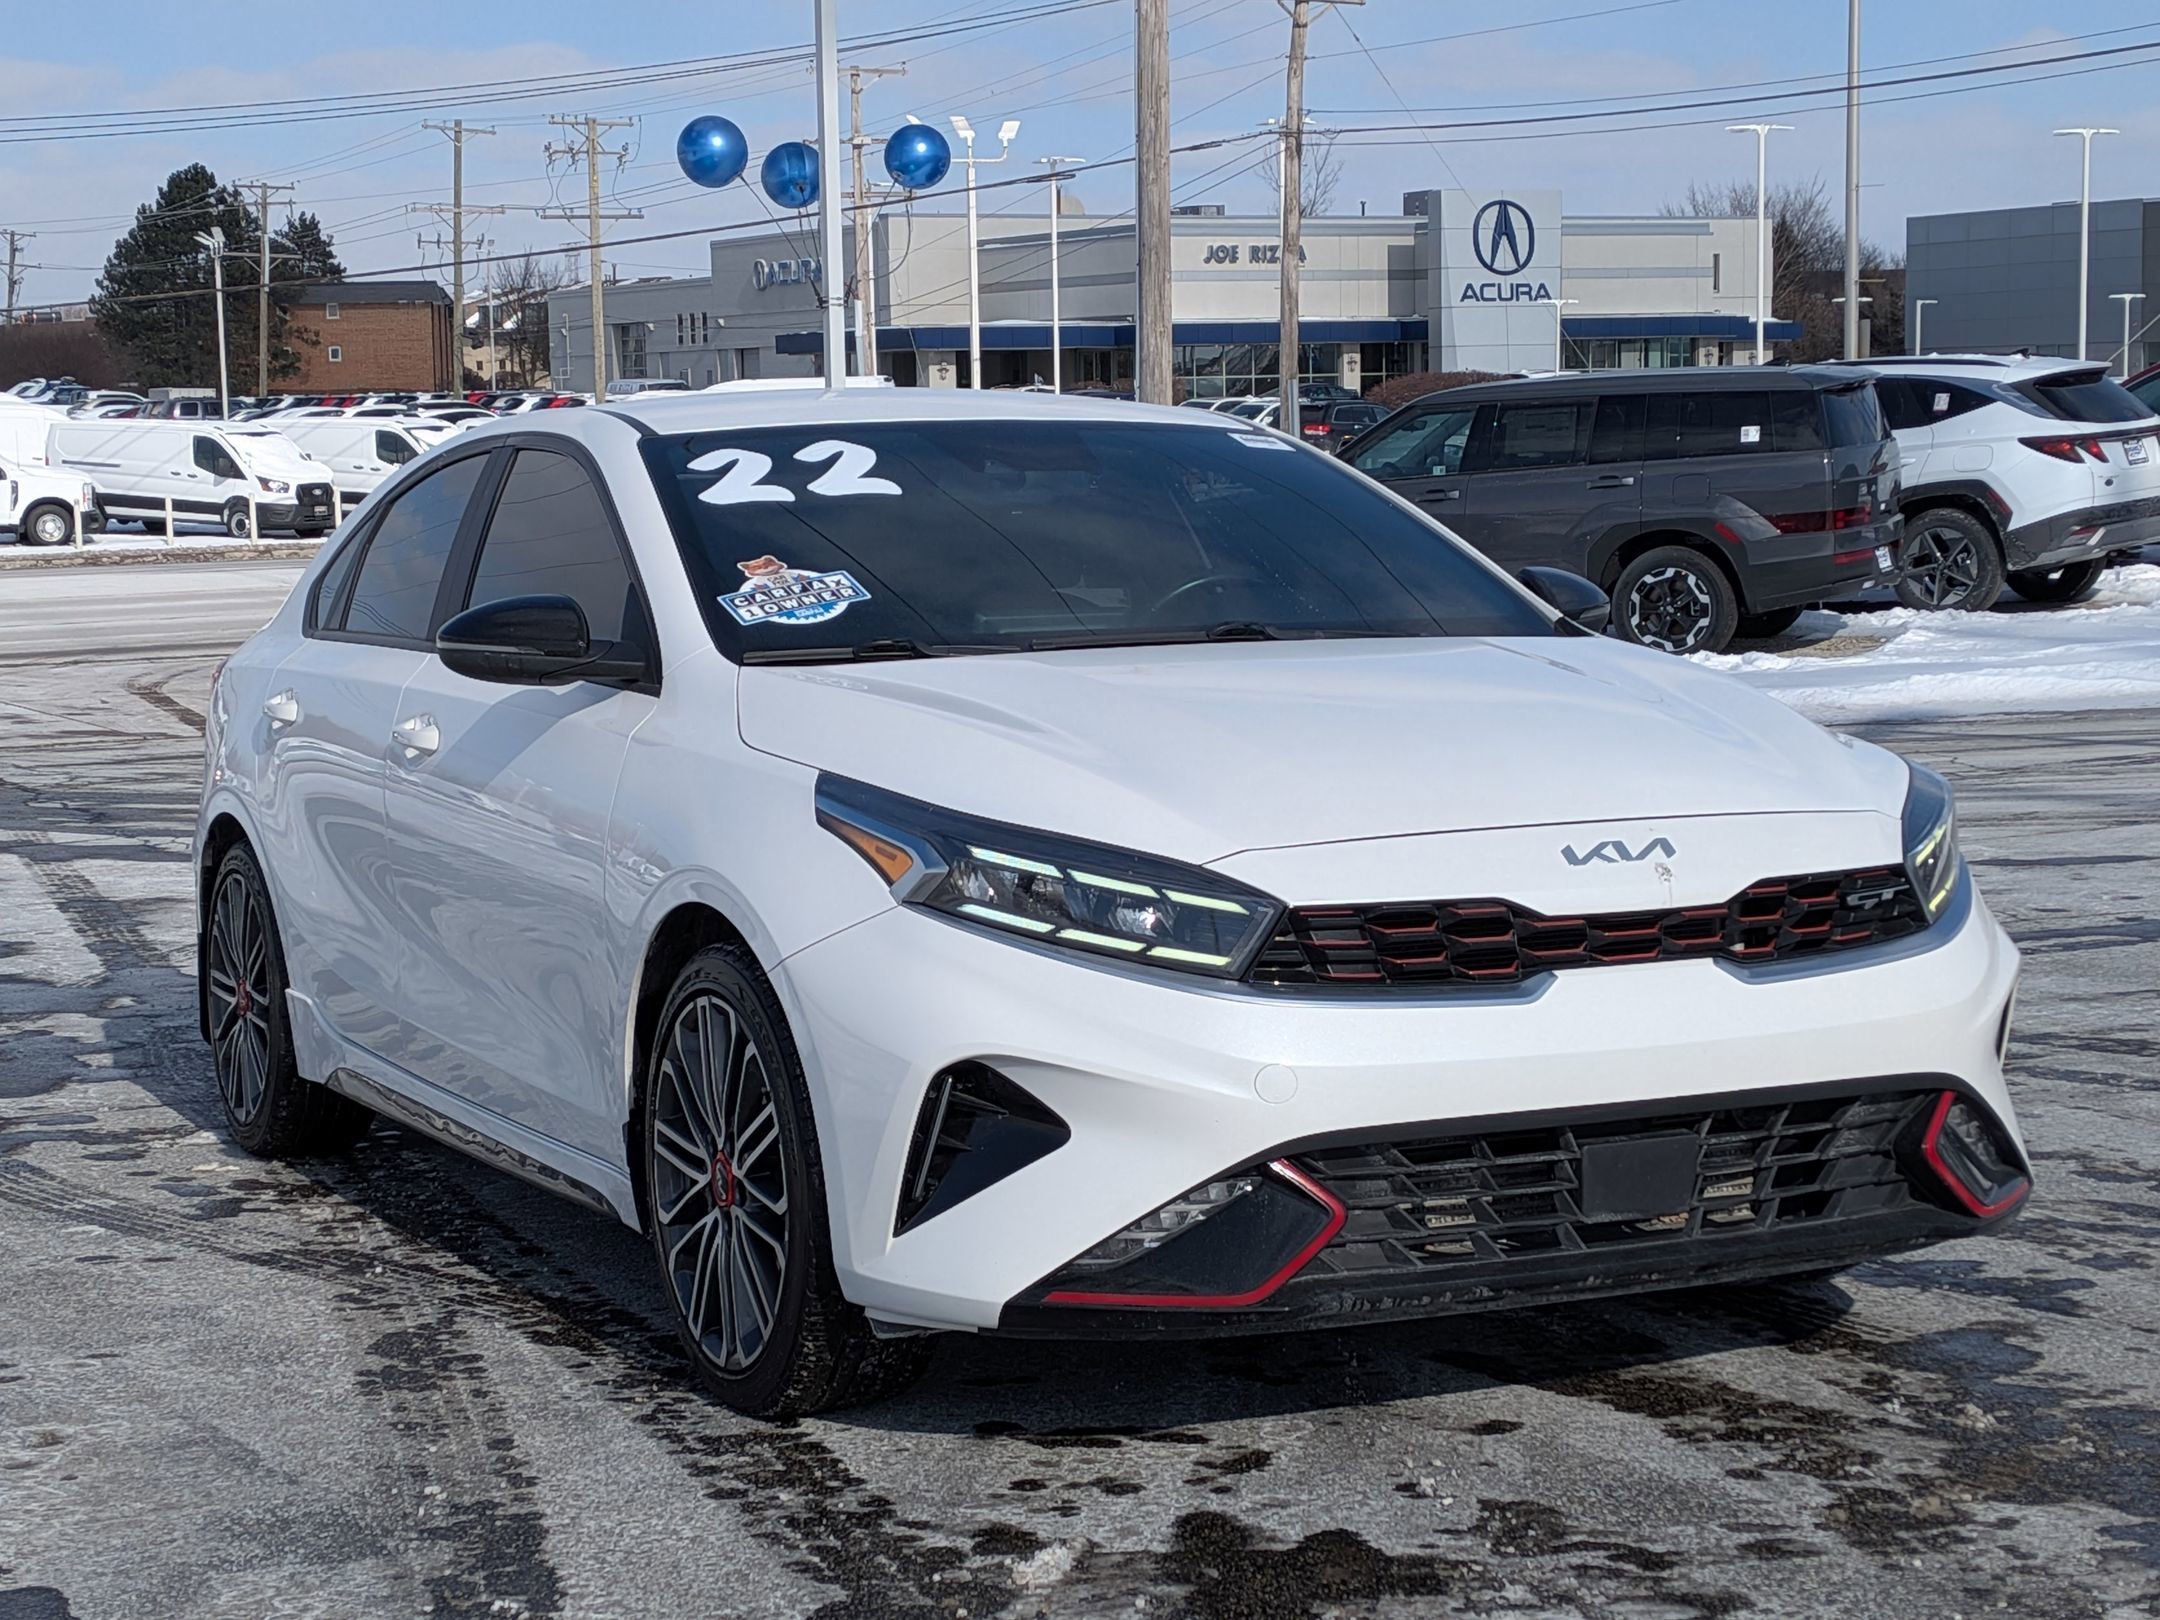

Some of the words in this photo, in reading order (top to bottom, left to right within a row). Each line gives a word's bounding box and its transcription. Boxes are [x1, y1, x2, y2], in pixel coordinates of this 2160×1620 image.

[1203, 244, 1240, 264] JOE
[1248, 244, 1307, 264] RIZA
[1460, 282, 1552, 302] ACURA
[686, 439, 904, 505] 22
[733, 577, 847, 607] CARFAX
[762, 587, 857, 615] OWNER
[1560, 837, 1676, 866] KIA
